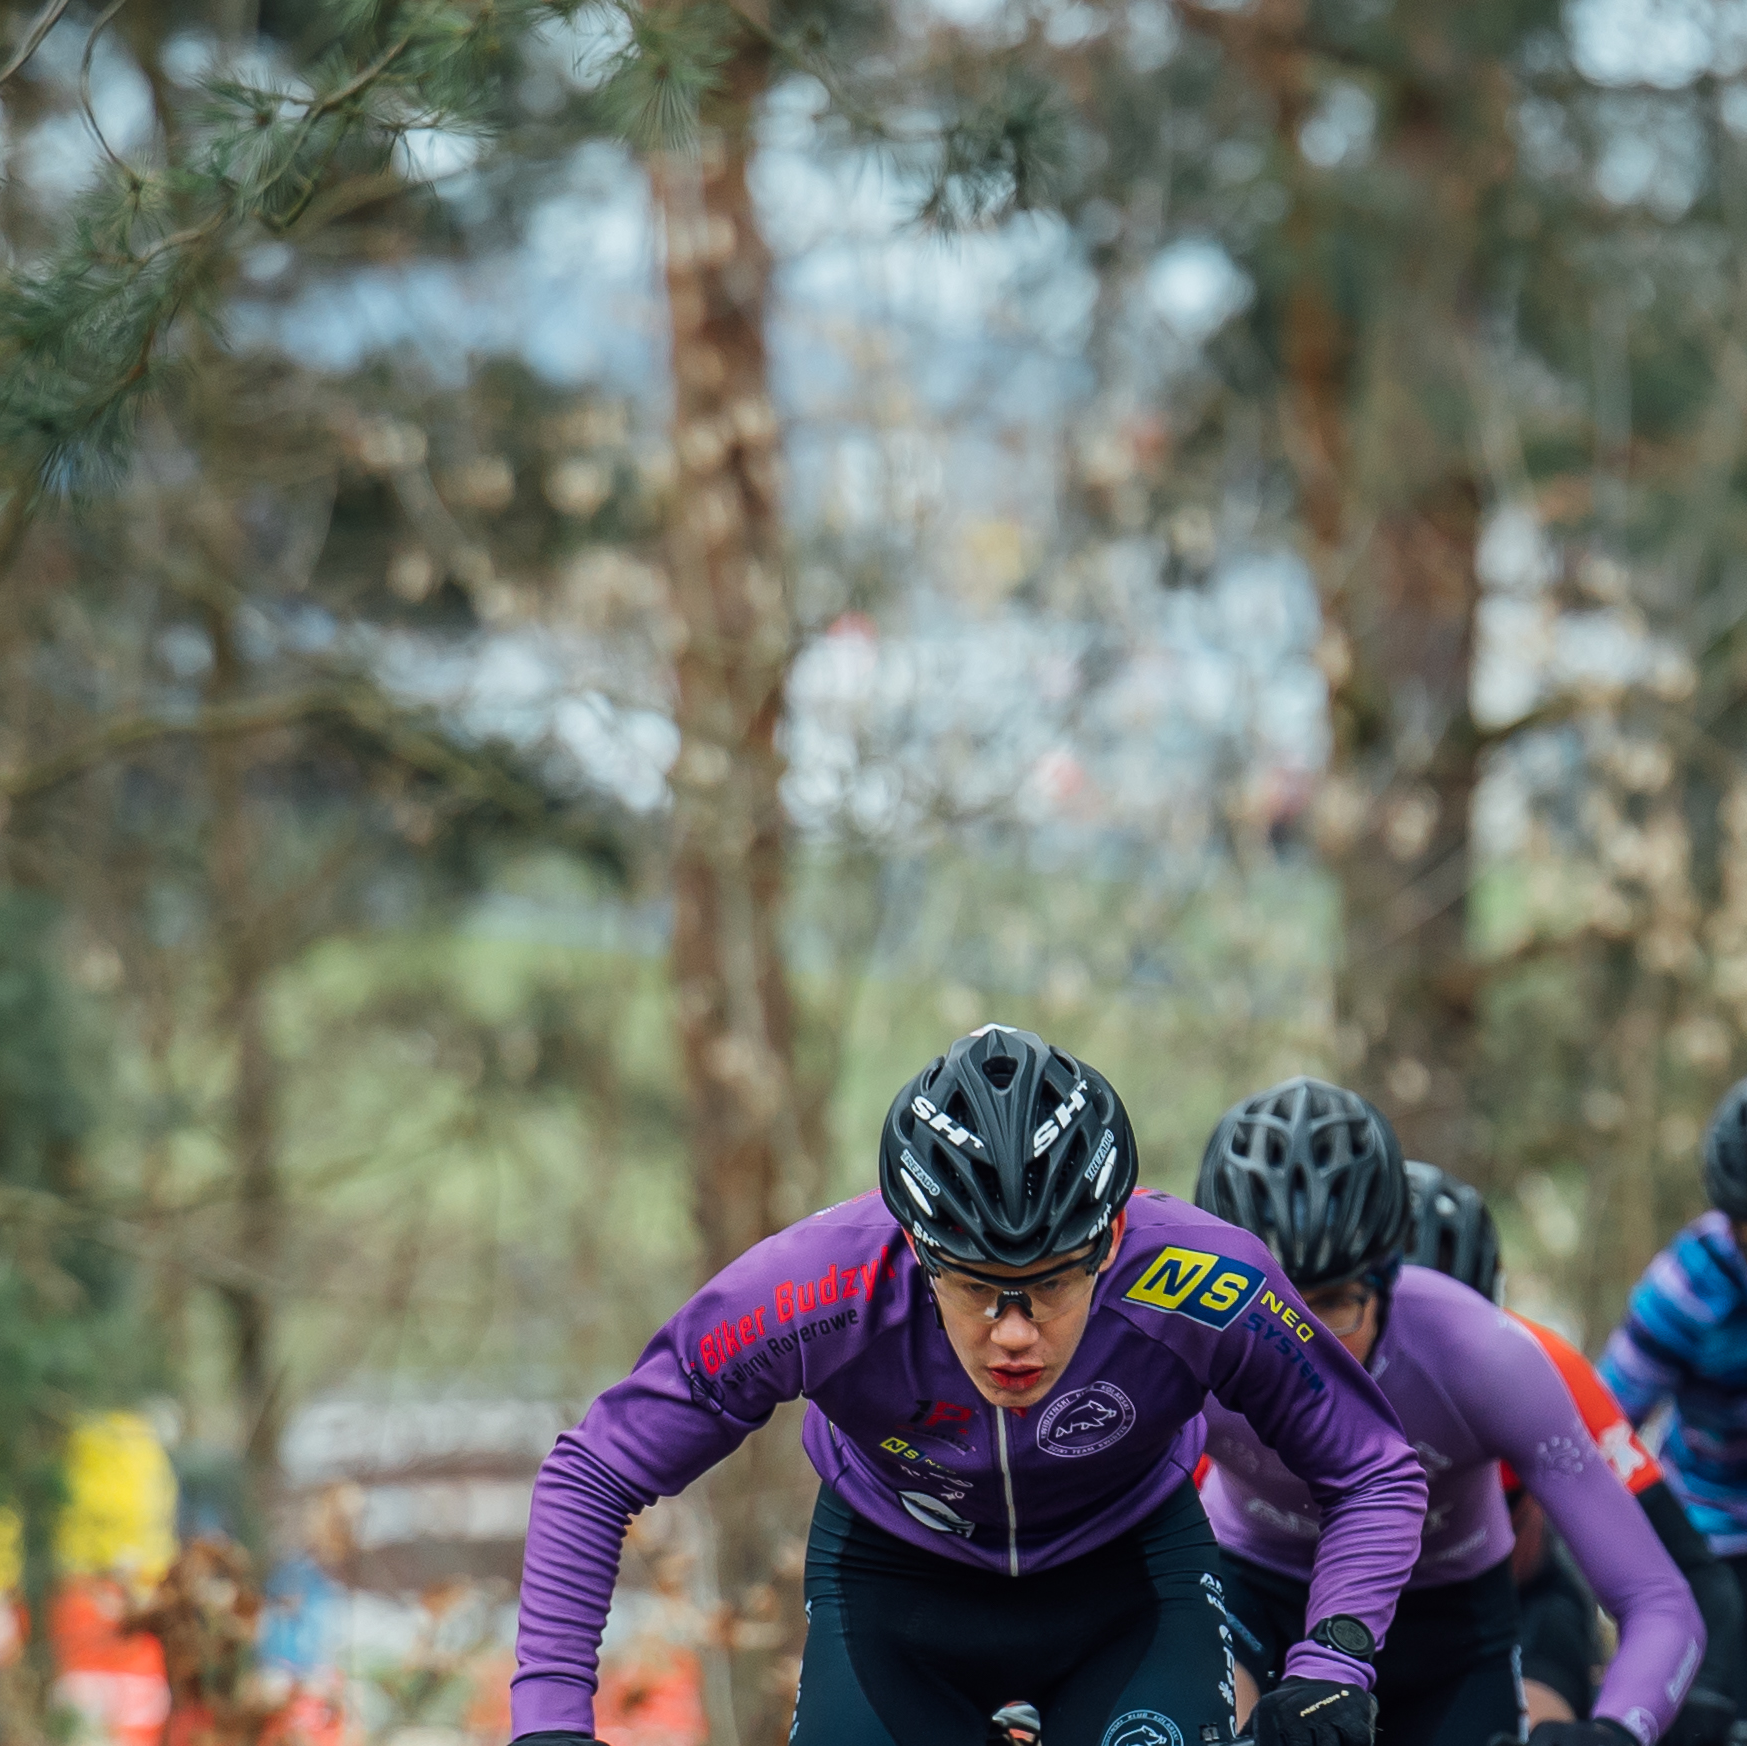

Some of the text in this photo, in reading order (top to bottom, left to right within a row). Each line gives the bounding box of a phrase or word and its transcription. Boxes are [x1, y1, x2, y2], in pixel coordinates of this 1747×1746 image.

[1143, 1257, 1250, 1312] NS
[699, 1305, 766, 1376] Biker
[1260, 1289, 1315, 1343] NEO
[720, 1350, 773, 1390] Salony
[1241, 1311, 1326, 1393] SYSTEM
